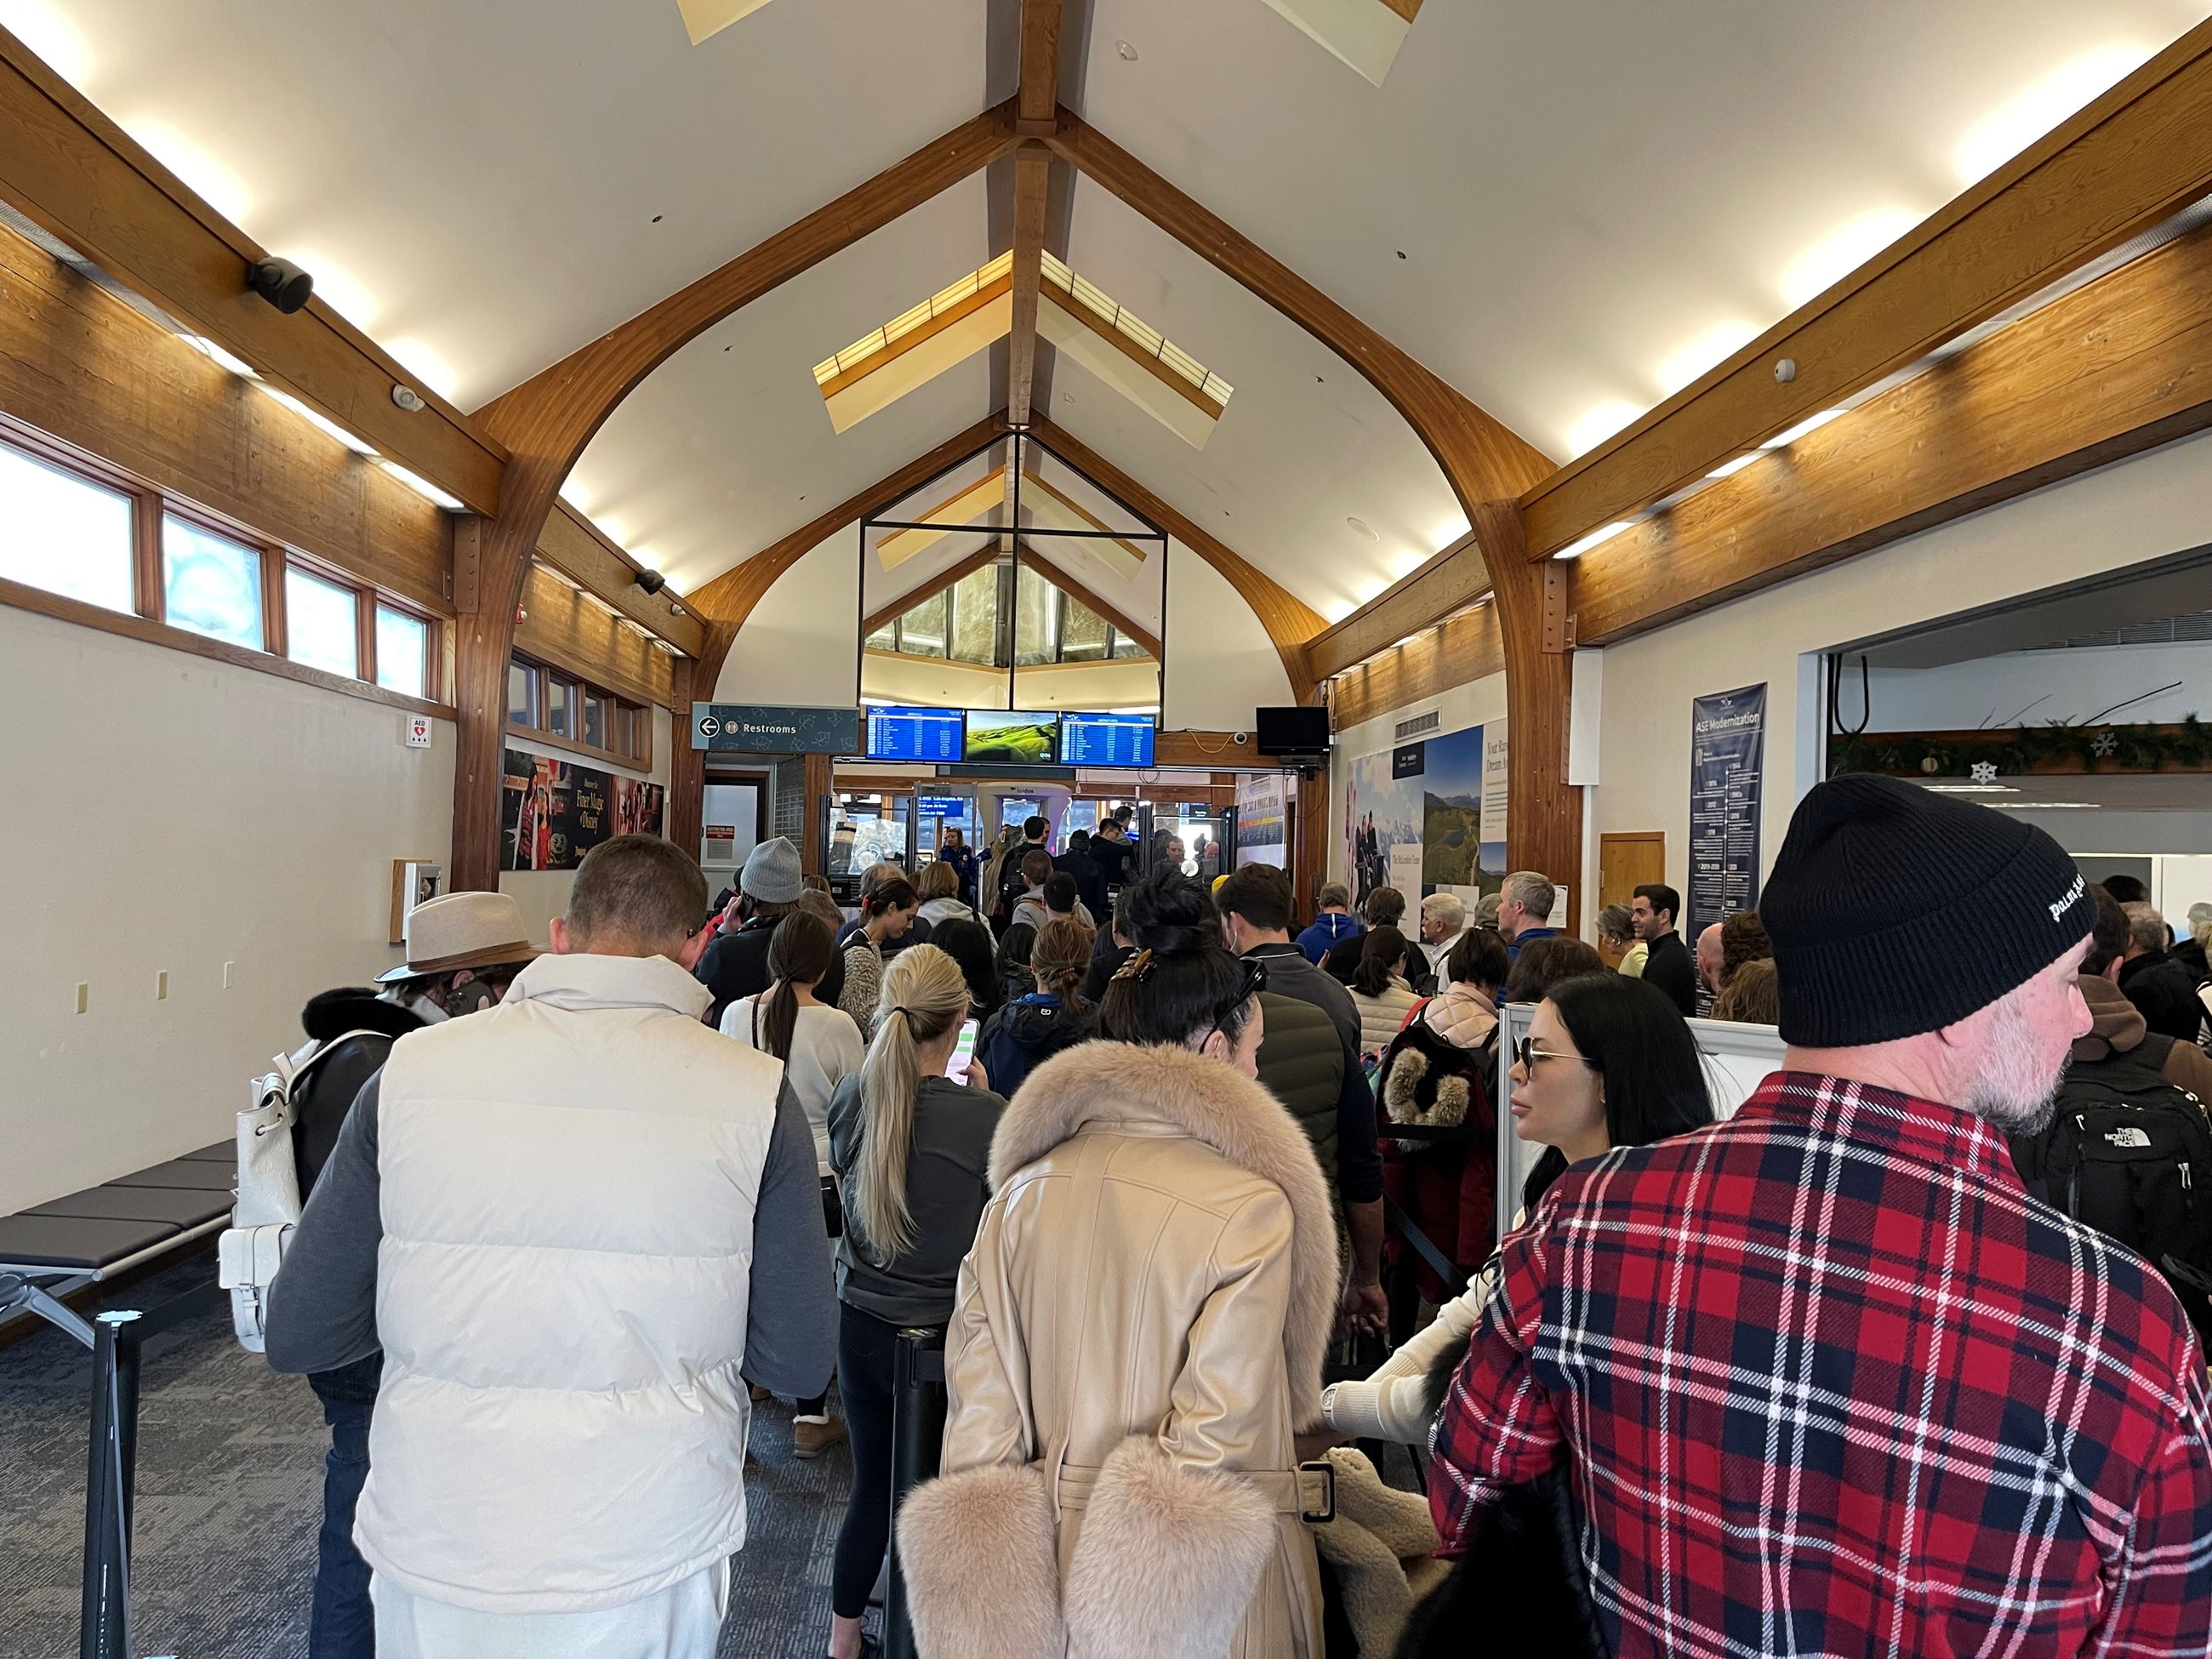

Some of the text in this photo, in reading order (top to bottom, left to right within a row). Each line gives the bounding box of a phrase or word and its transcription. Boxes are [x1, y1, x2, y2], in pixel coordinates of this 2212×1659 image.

[744, 723, 796, 734] Restrooms
[1696, 711, 1759, 733] ASE Modernization
[1486, 759, 1502, 772] Dream
